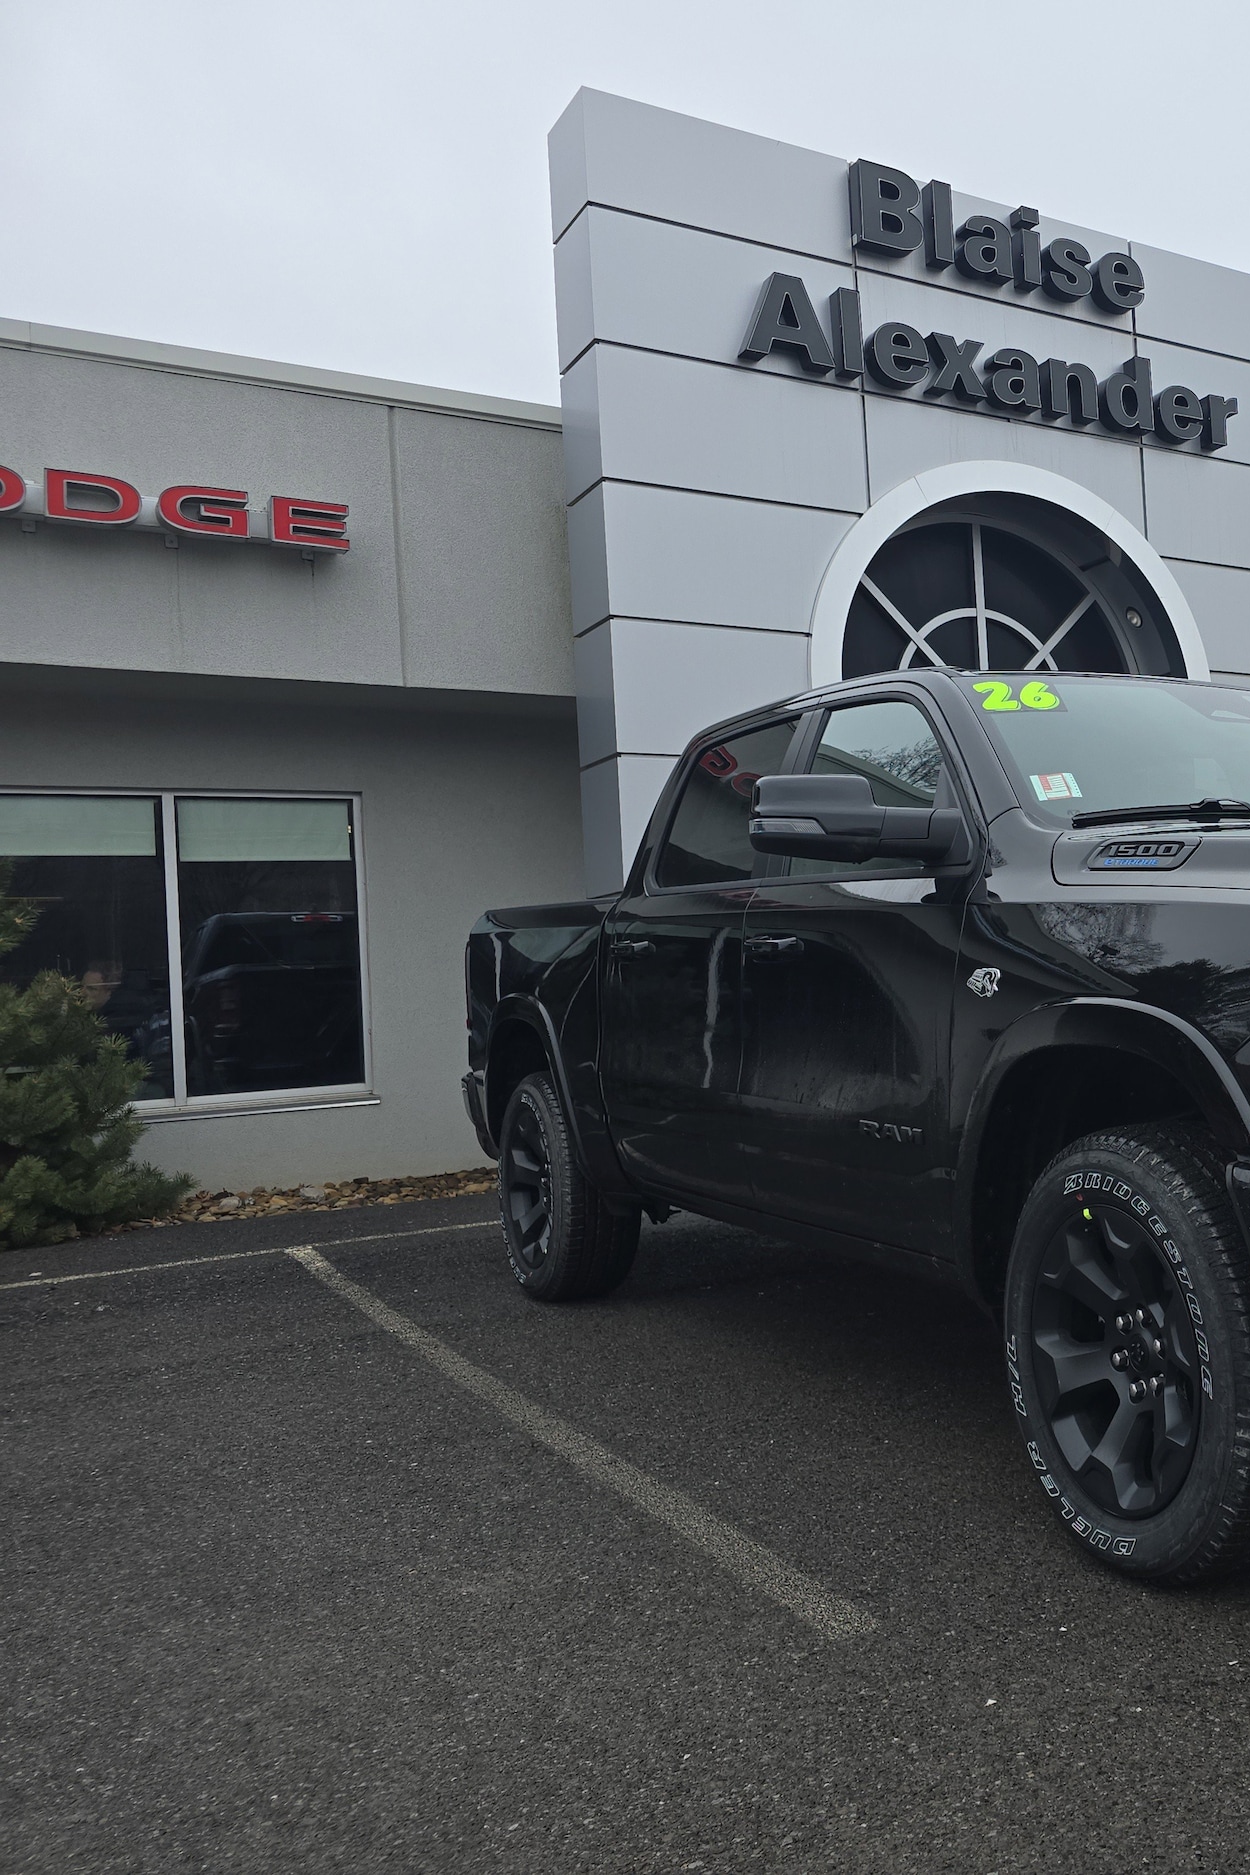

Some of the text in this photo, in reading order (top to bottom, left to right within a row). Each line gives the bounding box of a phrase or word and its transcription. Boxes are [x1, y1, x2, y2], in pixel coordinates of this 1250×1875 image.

[849, 158, 1145, 314] Blaise
[738, 271, 1239, 451] Alexander
[972, 681, 1060, 712] 26
[1107, 843, 1178, 857] 1500
[858, 1119, 924, 1146] RAM
[1063, 1172, 1214, 1400] BRIDGESTONE
[1026, 1441, 1137, 1556] DUELER
